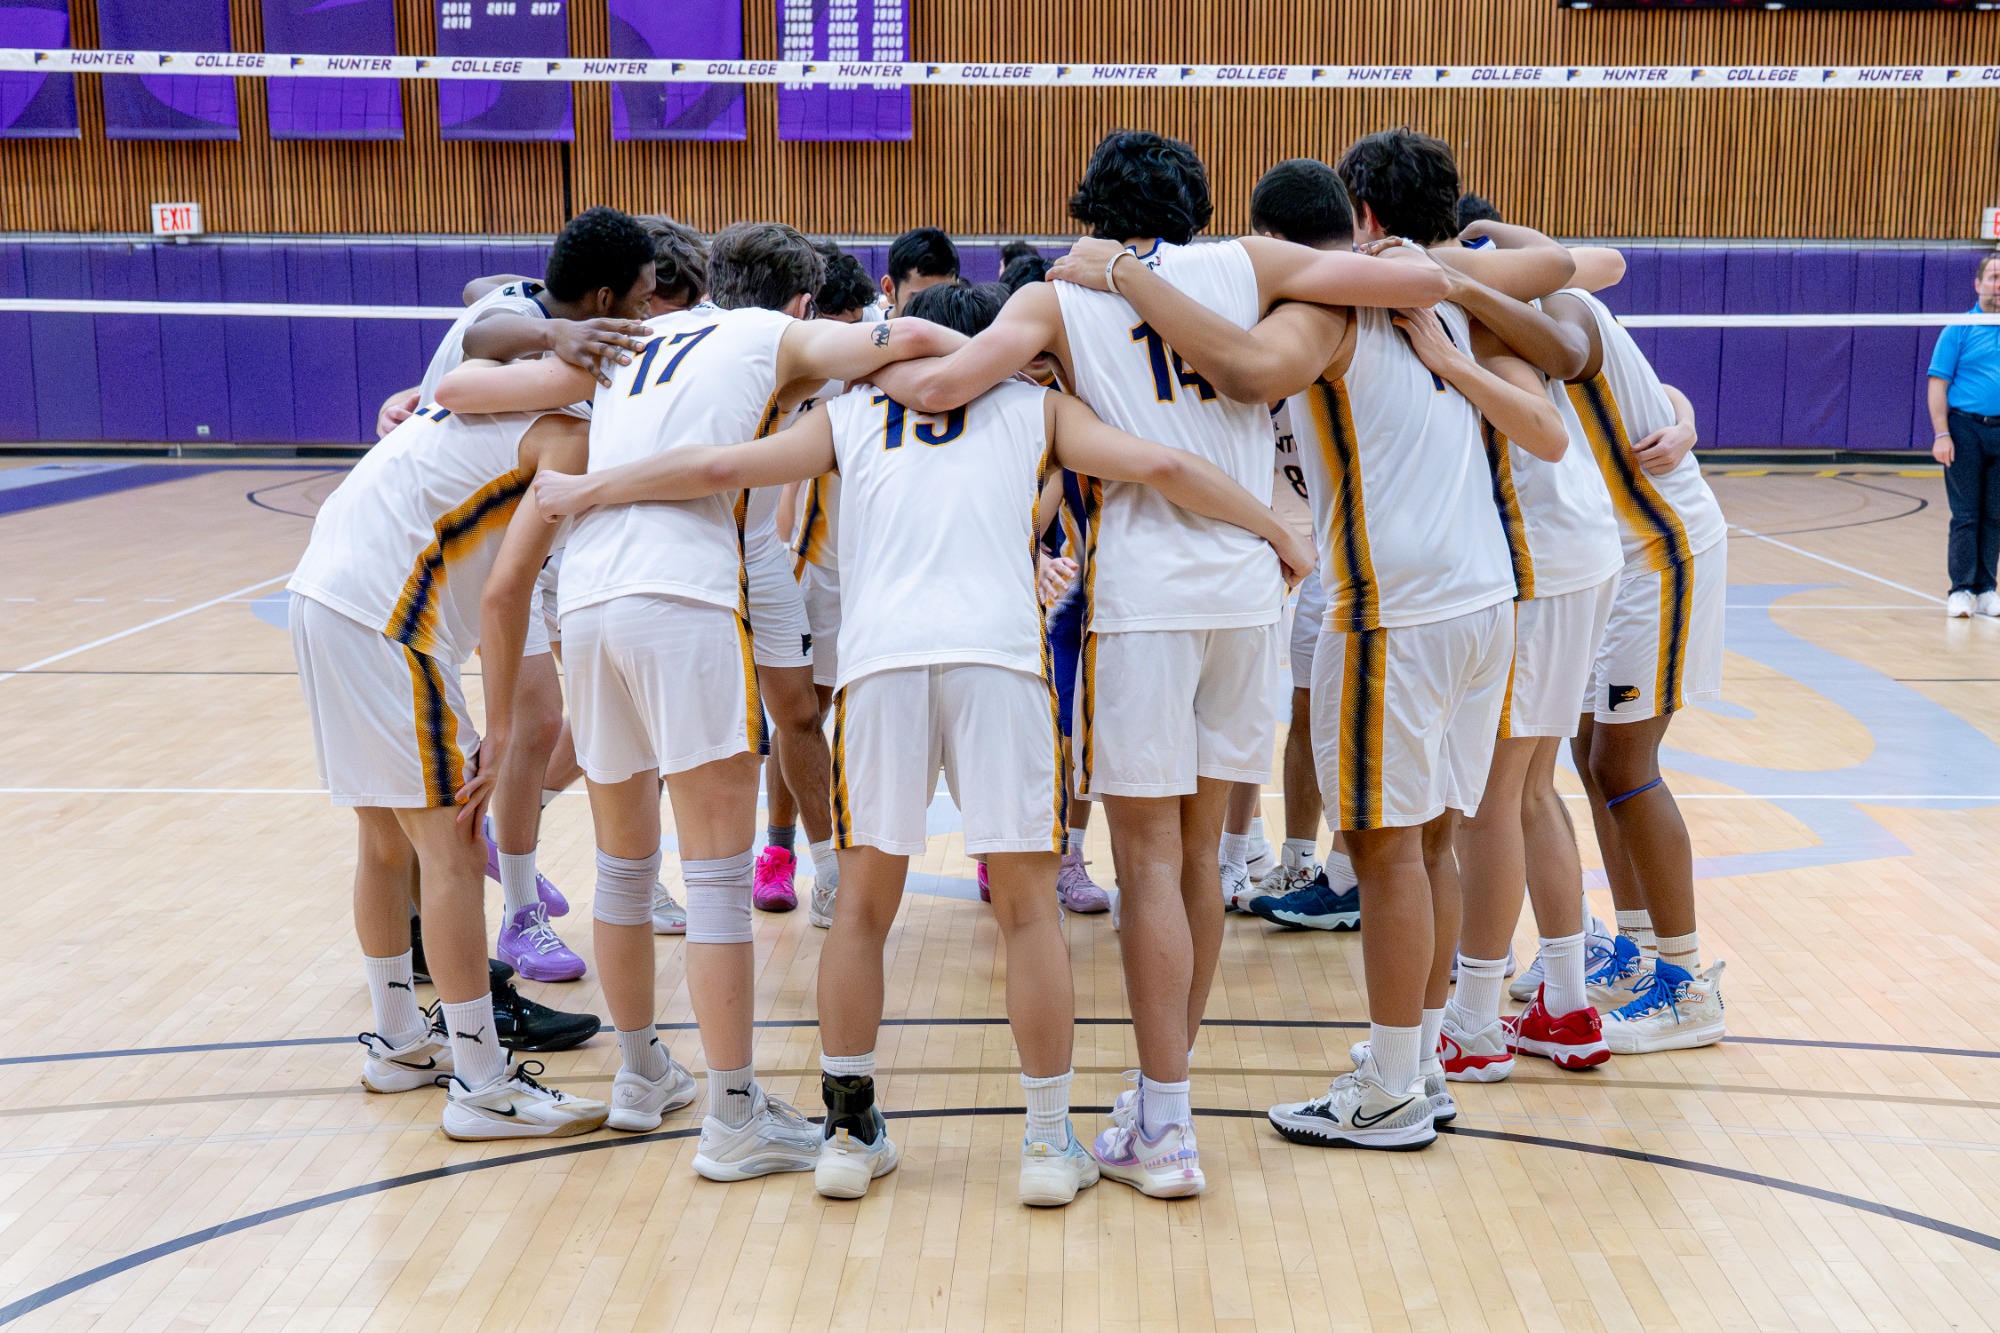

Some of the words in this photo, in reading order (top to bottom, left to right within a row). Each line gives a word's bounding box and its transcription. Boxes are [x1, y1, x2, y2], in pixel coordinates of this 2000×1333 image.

[70, 53, 135, 64] HUNTER
[194, 55, 265, 67] COLLEGE
[327, 58, 392, 70] HUNTER
[451, 61, 523, 73] COLLEGE
[583, 62, 648, 74] HUNTER
[707, 63, 777, 75] COLLEGE
[838, 64, 903, 76] HUNTER
[961, 66, 1033, 78] COLLEGE
[1092, 67, 1158, 78] HUNTER
[1216, 68, 1288, 79] COLLEGE
[1347, 69, 1413, 80] HUNTER
[1471, 69, 1542, 80] COLLEGE
[1602, 69, 1669, 80] HUNTER
[1727, 70, 1798, 81] COLLEGE
[1857, 70, 1924, 81] HUNTER
[160, 207, 191, 231] EXIT
[628, 323, 720, 398] 17
